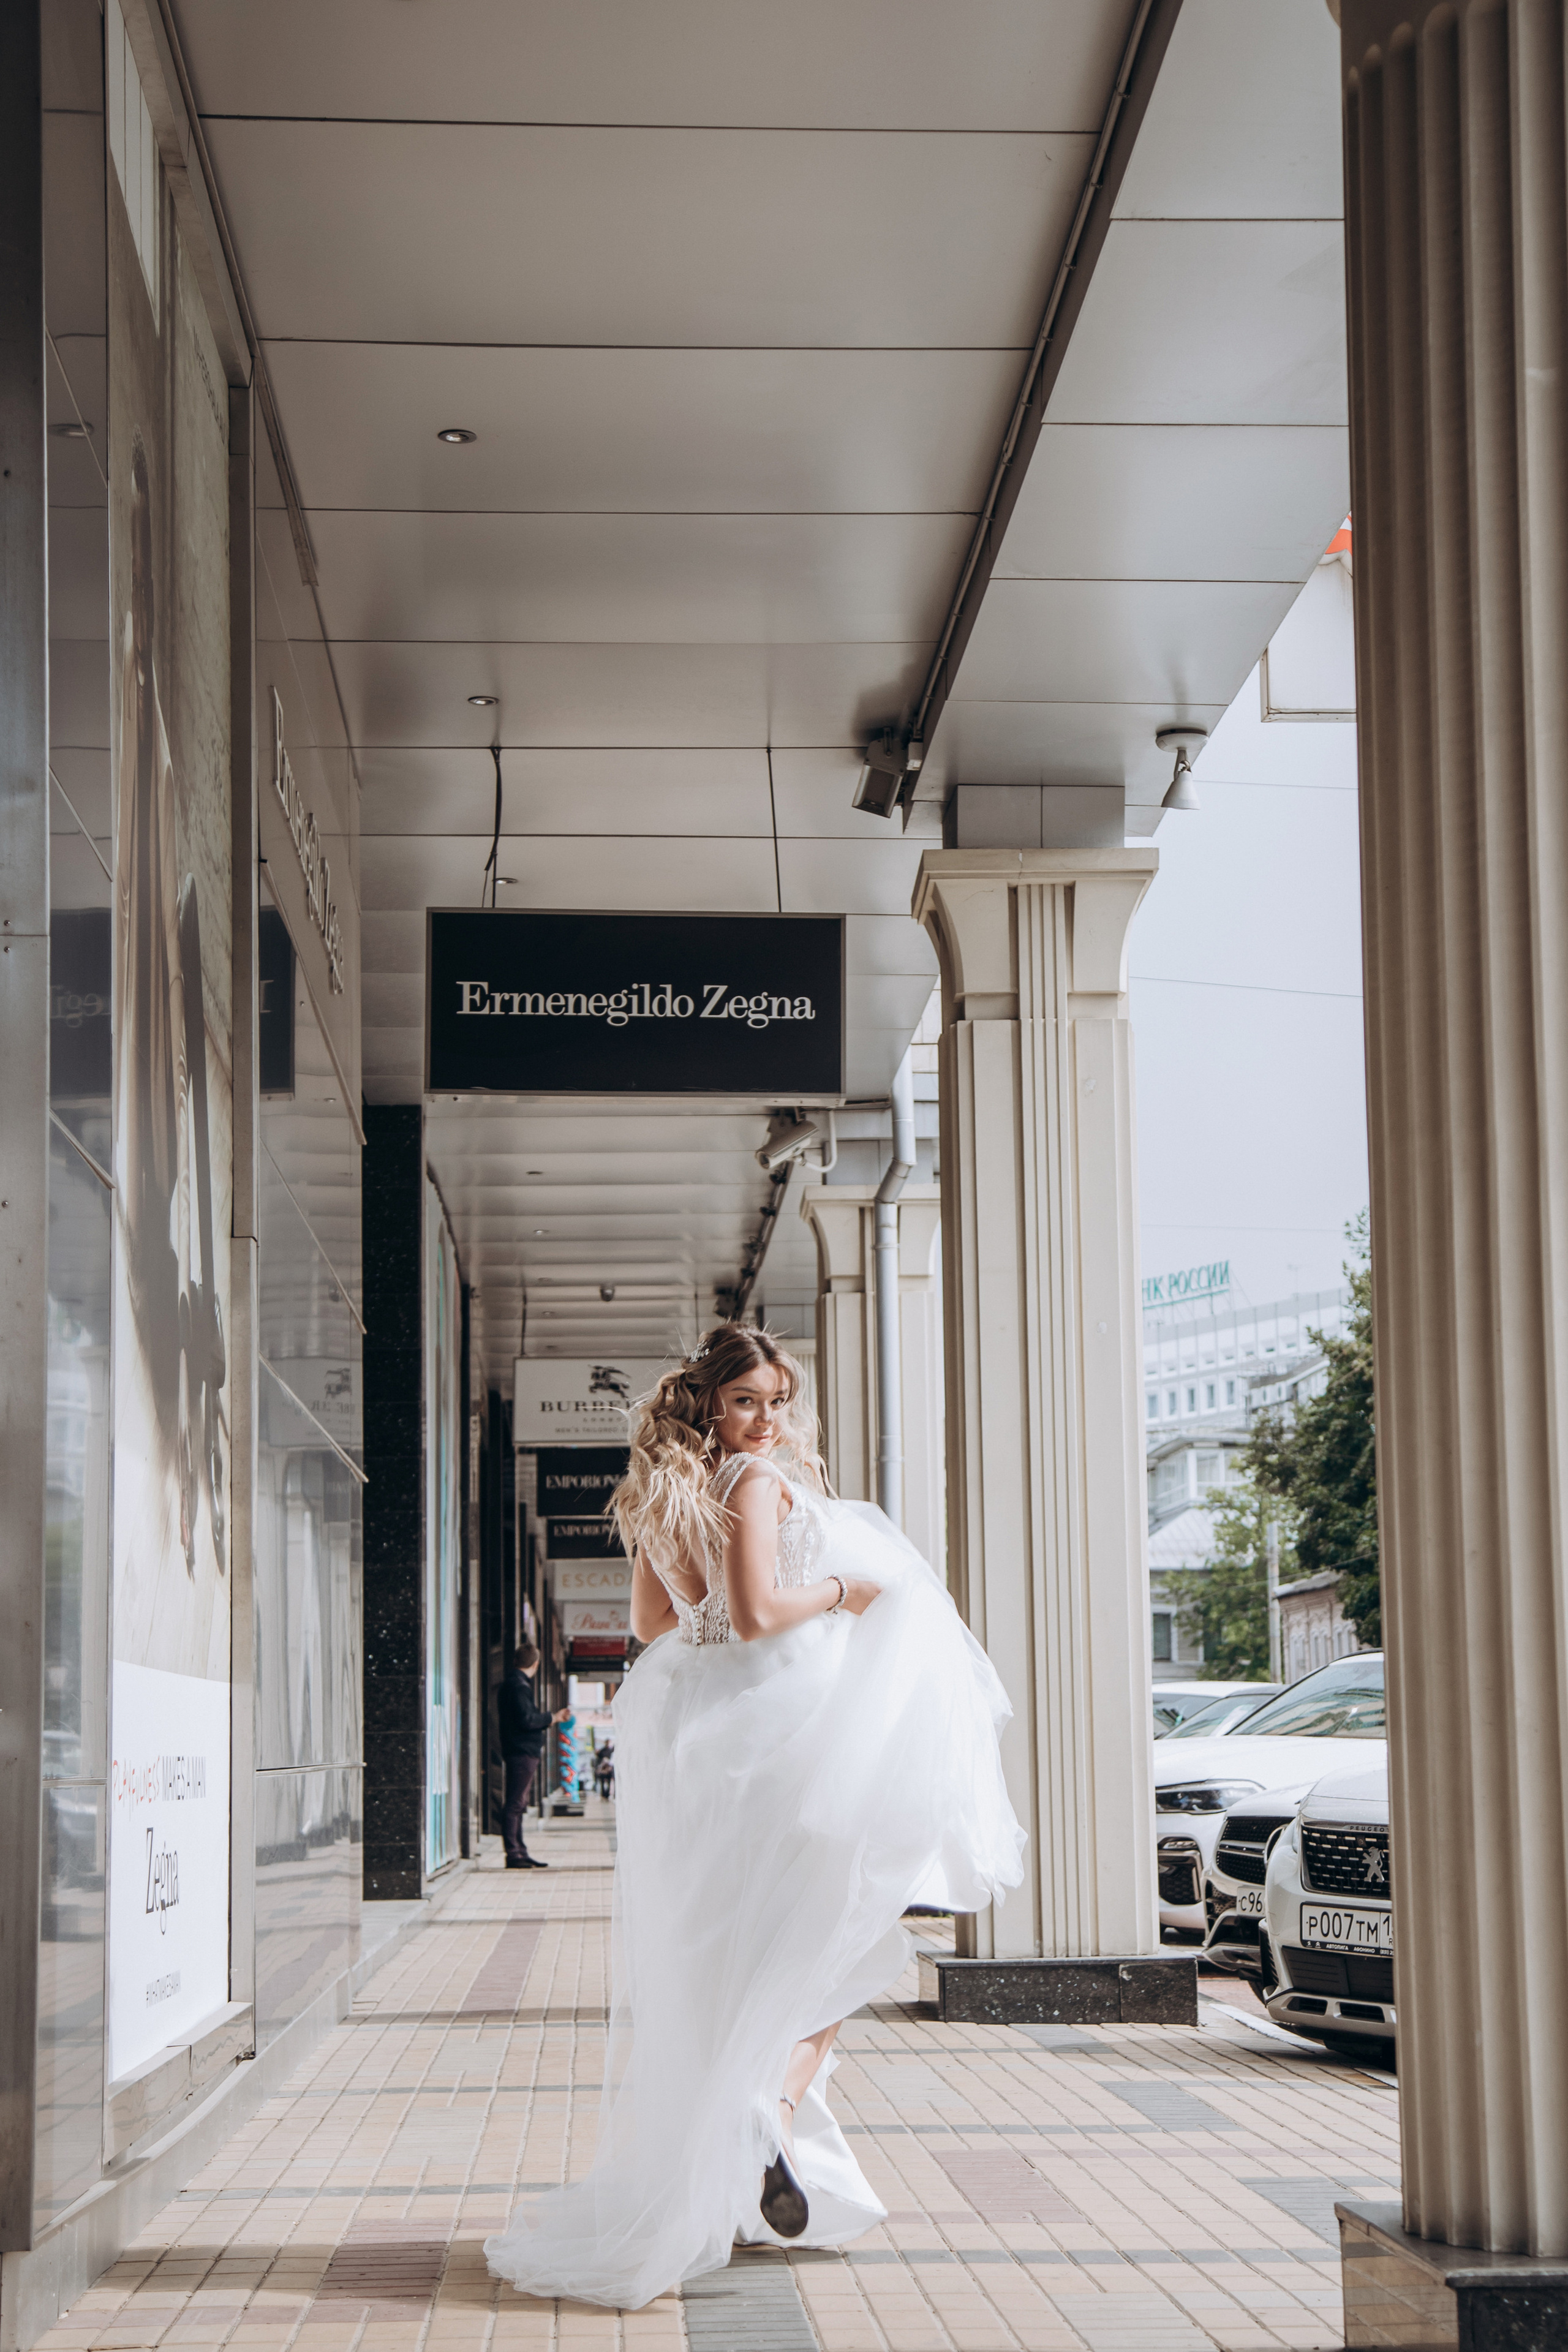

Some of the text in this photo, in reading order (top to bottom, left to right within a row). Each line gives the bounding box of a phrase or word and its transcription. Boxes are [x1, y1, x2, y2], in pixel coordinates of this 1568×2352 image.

[456, 981, 816, 1028] Ermenegildo Zegna
[1169, 1260, 1229, 1297] РОССИИ
[146, 1827, 179, 1935] Zegna
